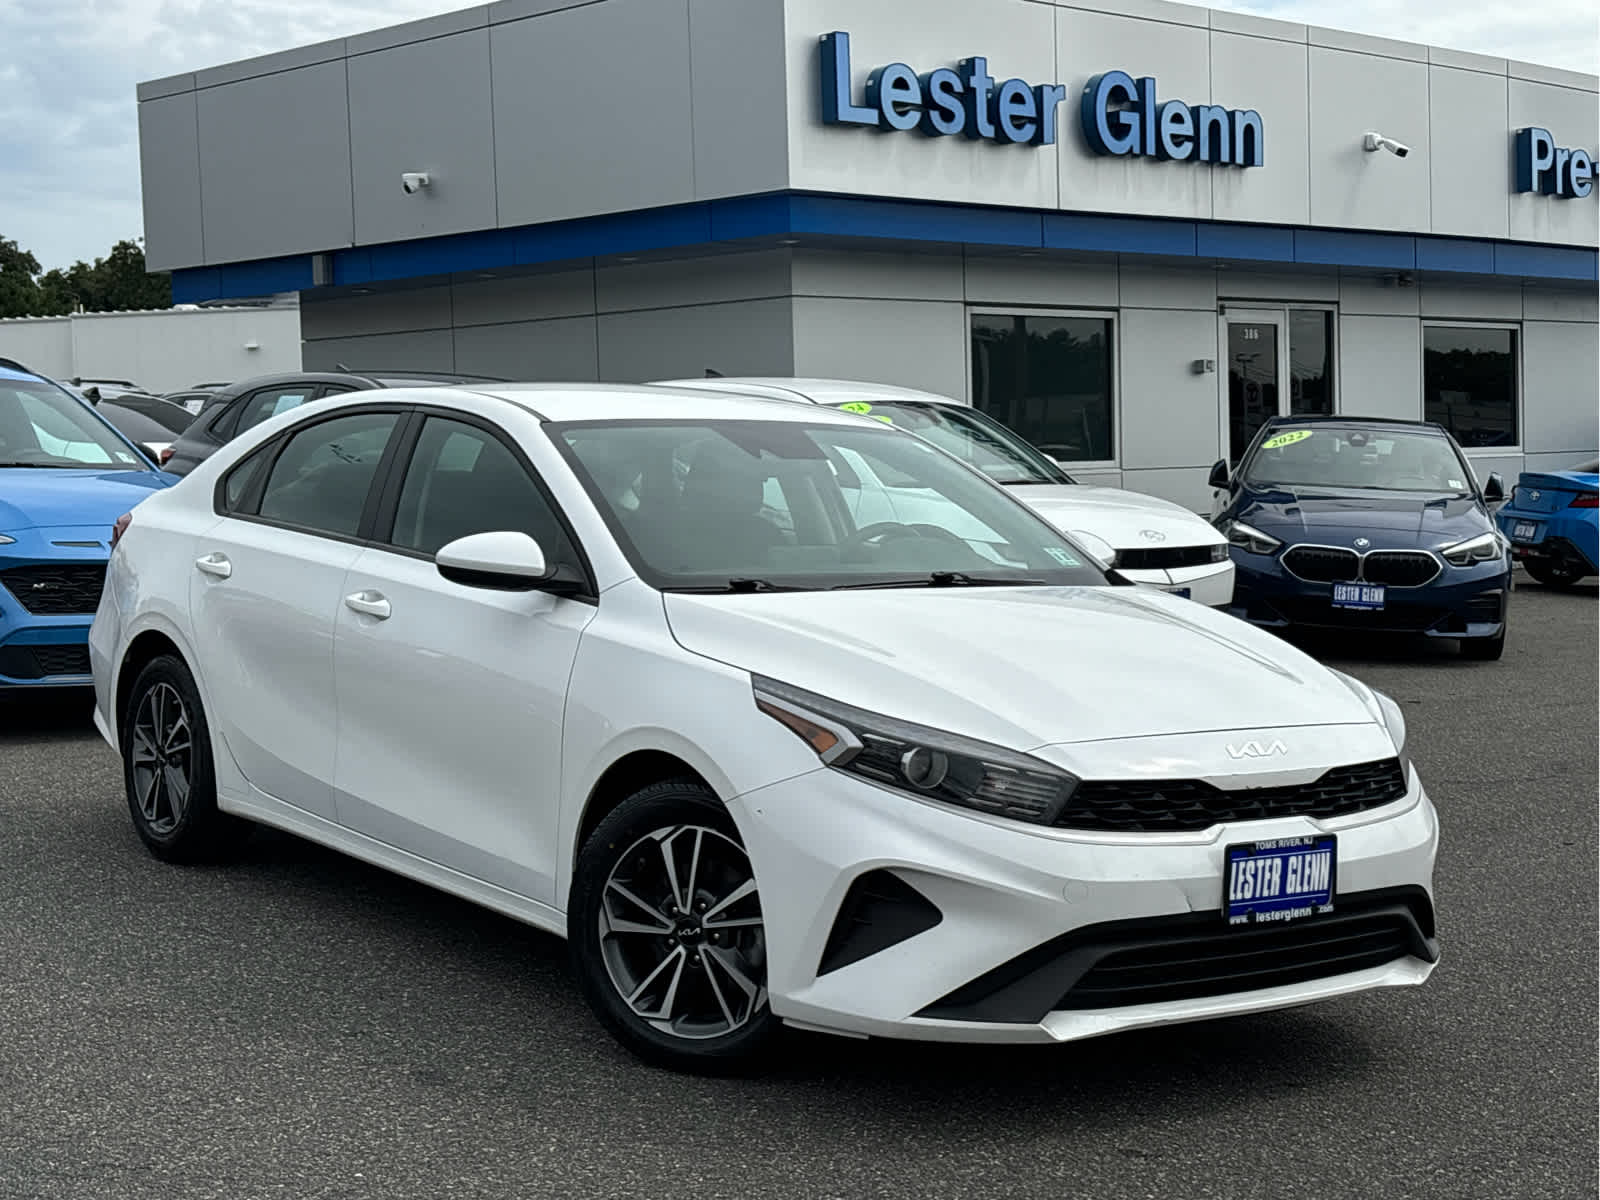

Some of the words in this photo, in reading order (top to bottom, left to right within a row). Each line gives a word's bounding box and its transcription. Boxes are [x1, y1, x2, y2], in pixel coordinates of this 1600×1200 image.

[820, 31, 1066, 145] Lester
[1082, 70, 1263, 167] Glenn
[1271, 431, 1304, 447] 2022
[1334, 585, 1360, 601] LESTER
[1361, 587, 1384, 602] GLENN
[1225, 740, 1288, 759] KIA
[1255, 841, 1277, 850] TOMS
[1303, 837, 1313, 845] NJ
[1229, 857, 1282, 900] LESTER
[1286, 852, 1331, 895] GLENN
[1255, 907, 1312, 923] lesterglenn
[677, 927, 701, 936] KIA
